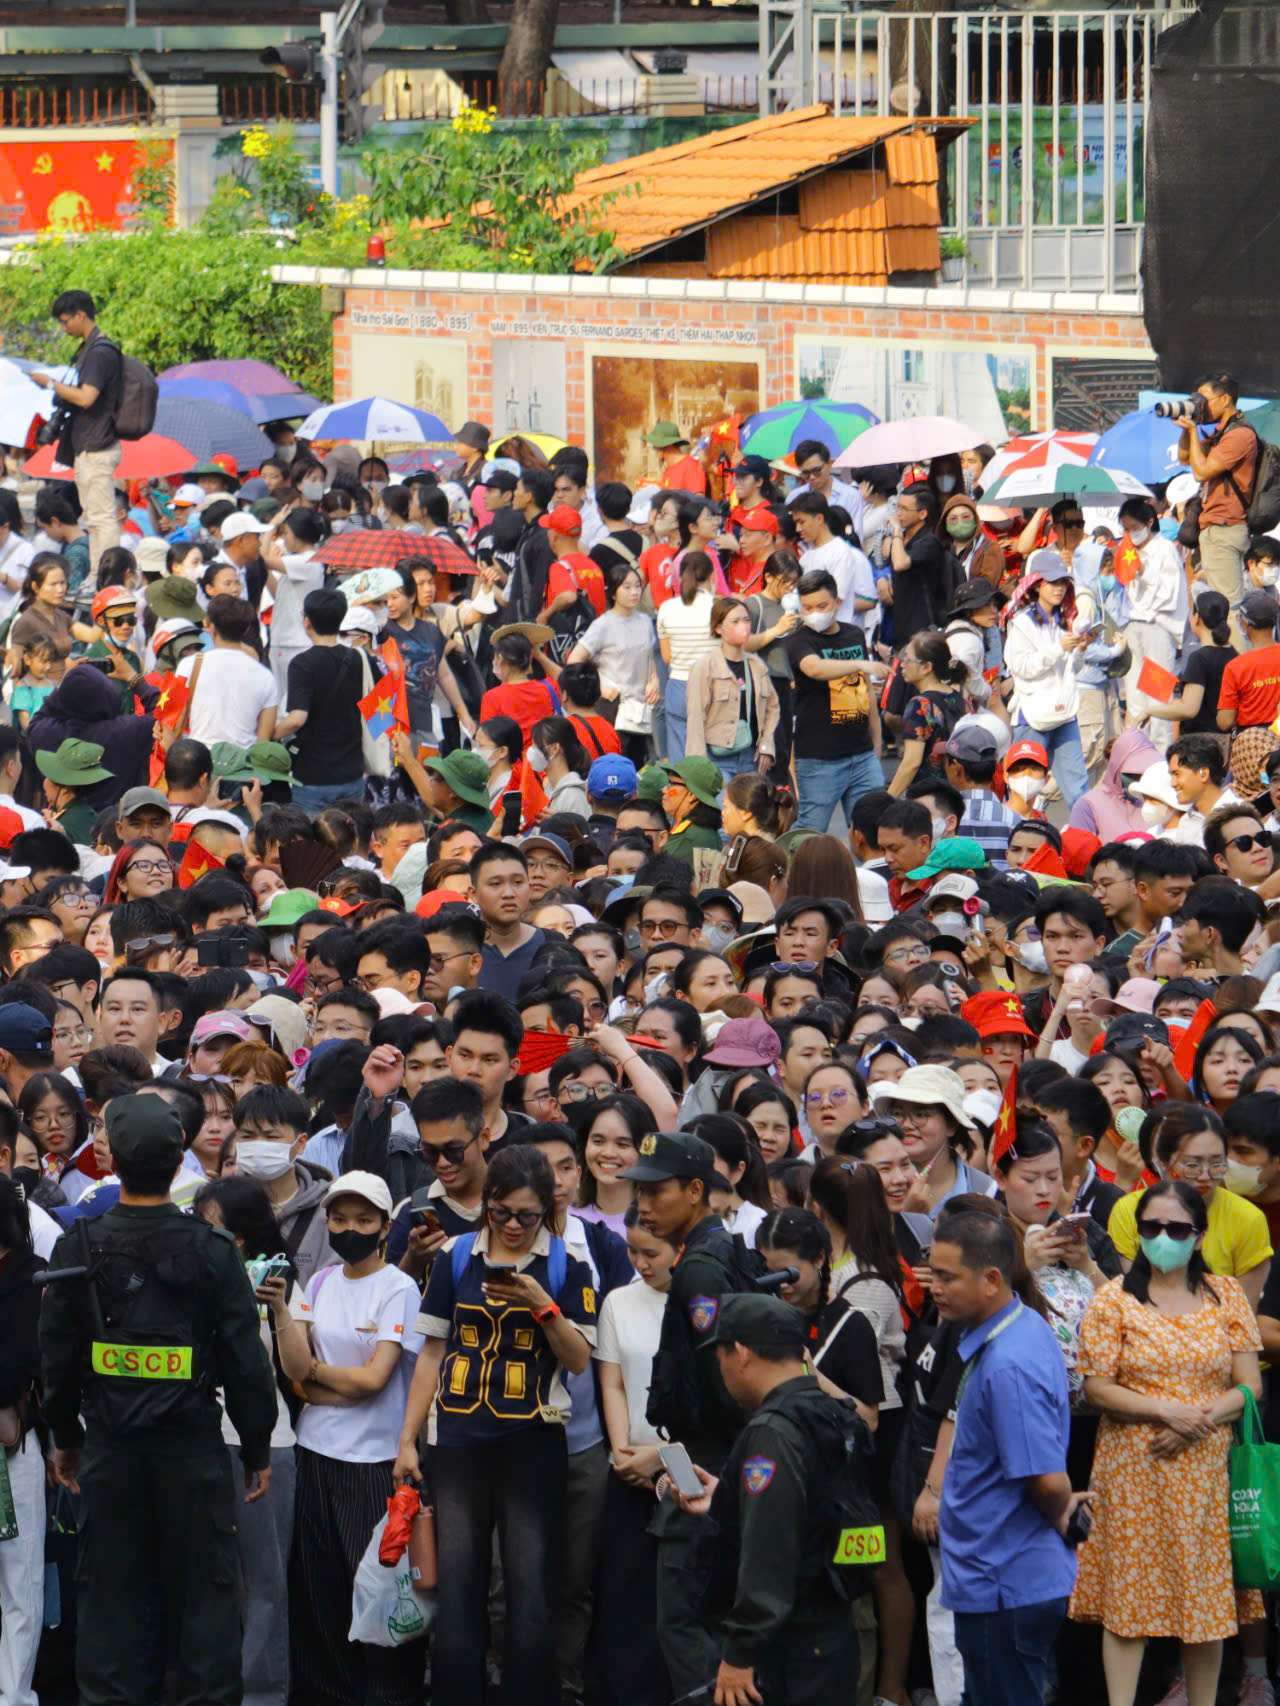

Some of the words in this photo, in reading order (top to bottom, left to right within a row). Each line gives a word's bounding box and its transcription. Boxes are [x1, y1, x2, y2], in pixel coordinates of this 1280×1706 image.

[1091, 143, 1127, 152] NION
[102, 1350, 183, 1372] CSCĐ
[438, 1303, 546, 1419] 88
